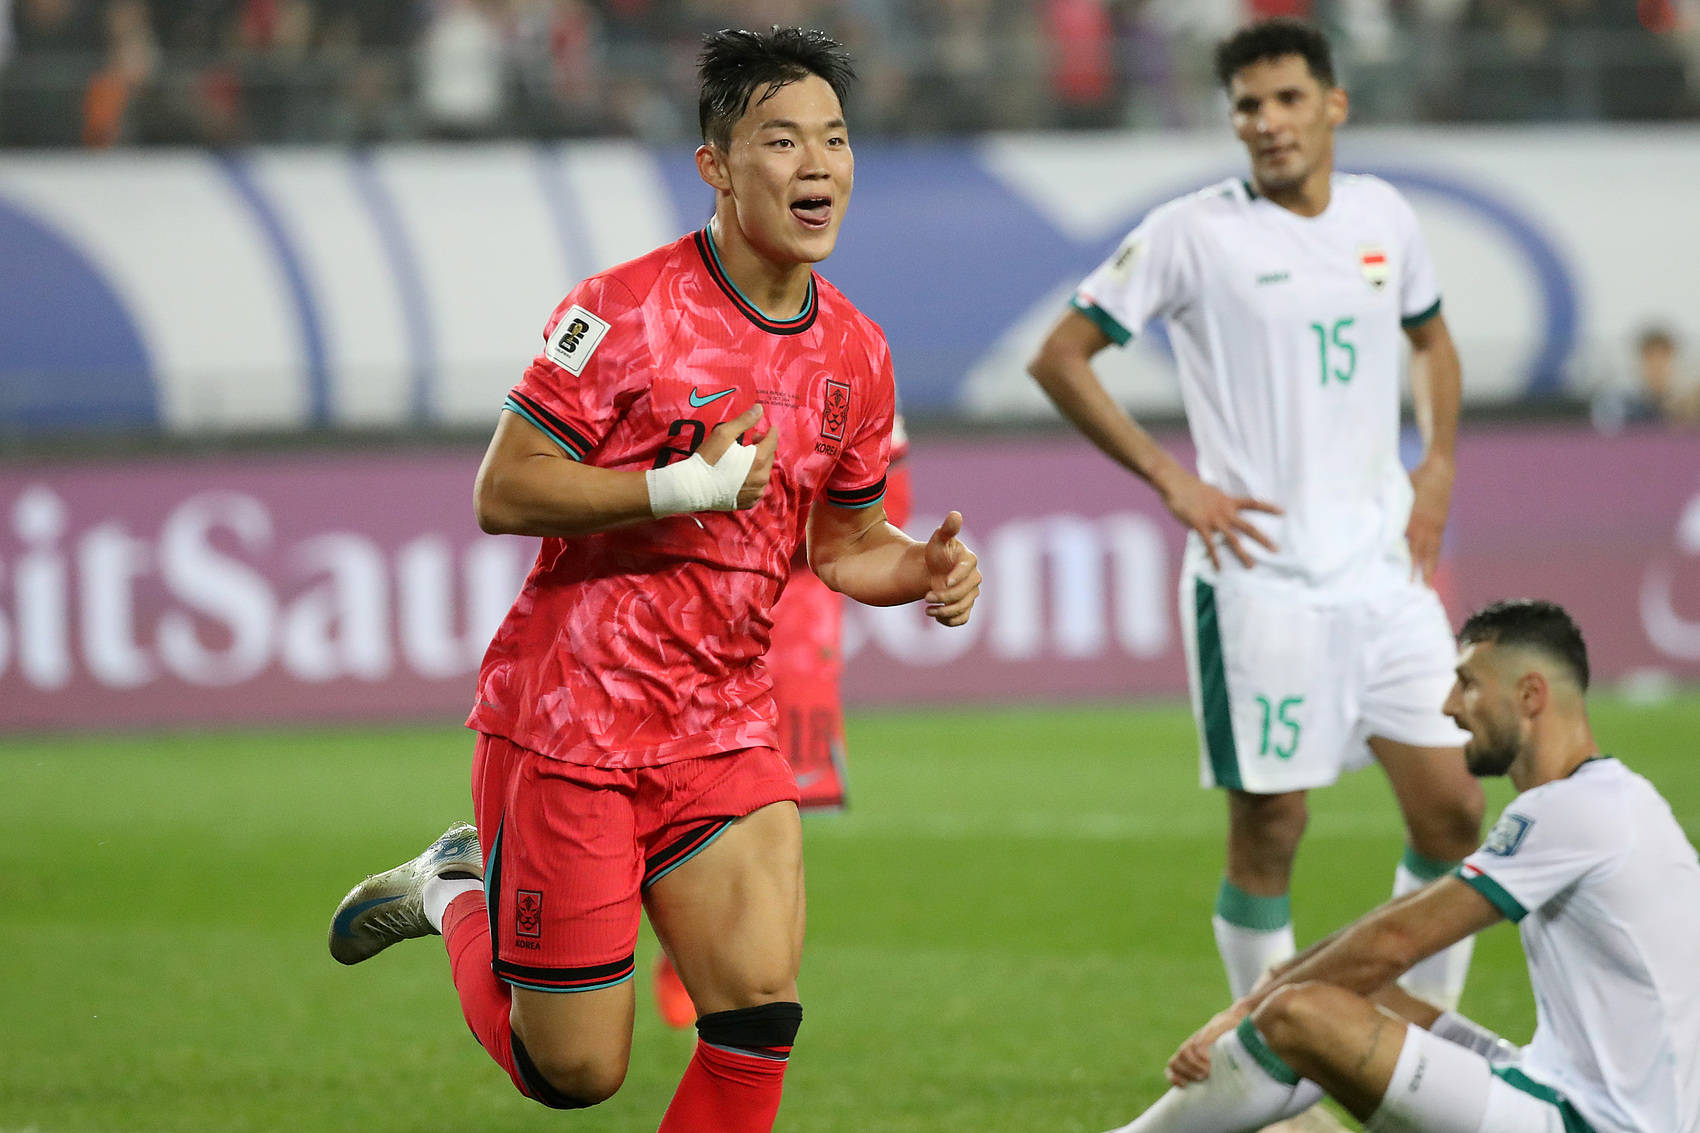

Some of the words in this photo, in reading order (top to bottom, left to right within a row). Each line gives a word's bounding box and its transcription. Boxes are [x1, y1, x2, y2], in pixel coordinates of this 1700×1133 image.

[1310, 317, 1357, 386] 15
[1255, 694, 1304, 760] 15
[515, 938, 541, 951] KOREA
